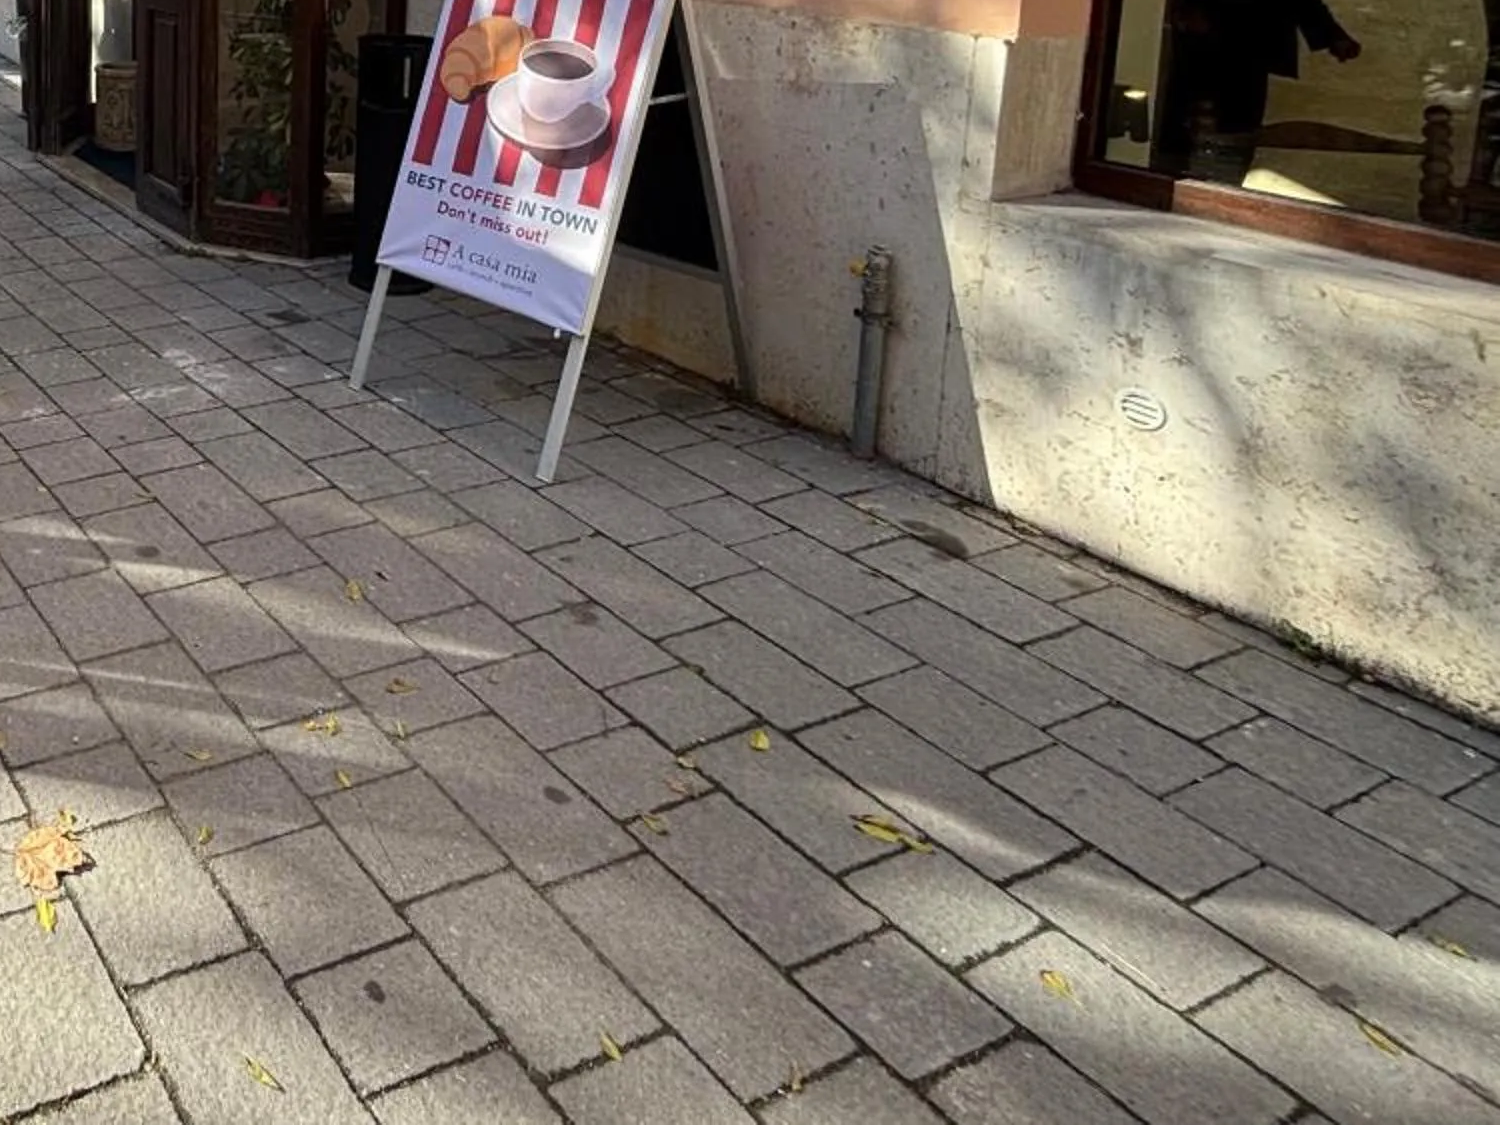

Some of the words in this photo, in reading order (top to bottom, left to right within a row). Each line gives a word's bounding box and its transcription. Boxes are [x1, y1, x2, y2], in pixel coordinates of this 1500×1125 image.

[407, 170, 447, 193] BEST
[450, 182, 514, 211] COFFEE
[516, 199, 537, 218] IN
[541, 206, 598, 235] TOWN
[437, 200, 477, 224] Don't
[480, 214, 511, 234] miss
[515, 225, 549, 245] out!
[452, 244, 465, 260] A
[469, 251, 501, 272] casa
[504, 262, 538, 284] mia
